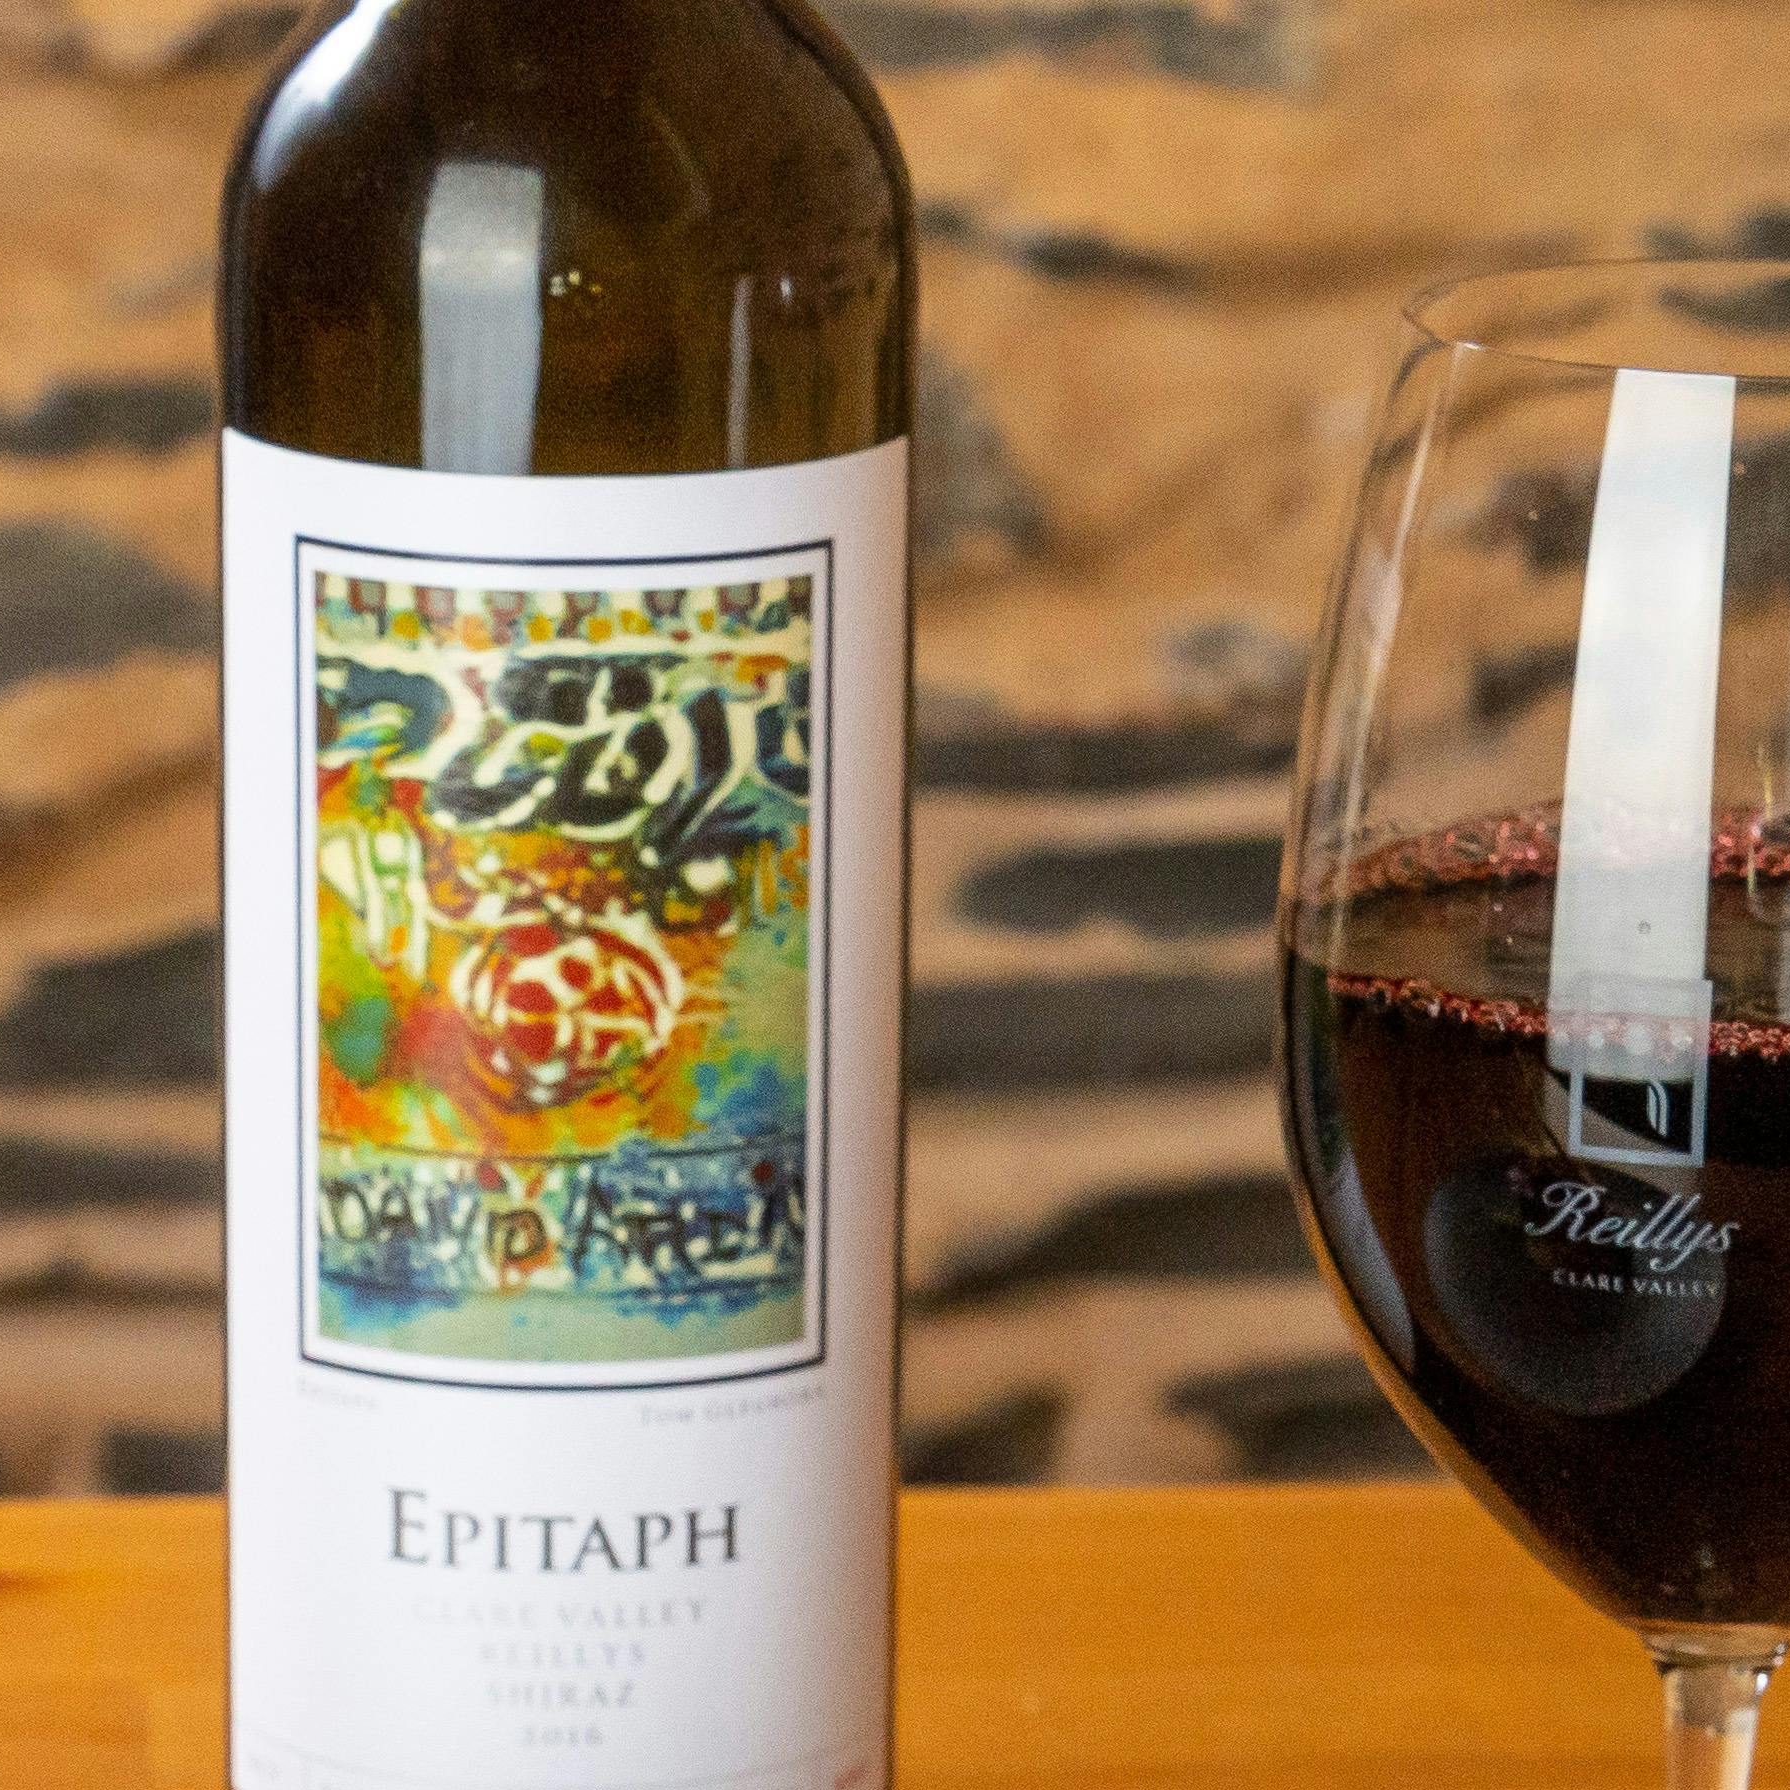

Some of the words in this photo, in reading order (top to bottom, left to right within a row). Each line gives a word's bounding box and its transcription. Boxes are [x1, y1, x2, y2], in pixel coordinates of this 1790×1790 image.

[1524, 1180, 1743, 1272] Reillys
[1552, 1268, 1624, 1293] CLARE
[1632, 1276, 1721, 1298] VALLEY
[412, 1597, 536, 1628] CLARE
[557, 1598, 707, 1629] VALLEY
[479, 1642, 646, 1668] REILLYS
[485, 1681, 639, 1708] SHIRAZ
